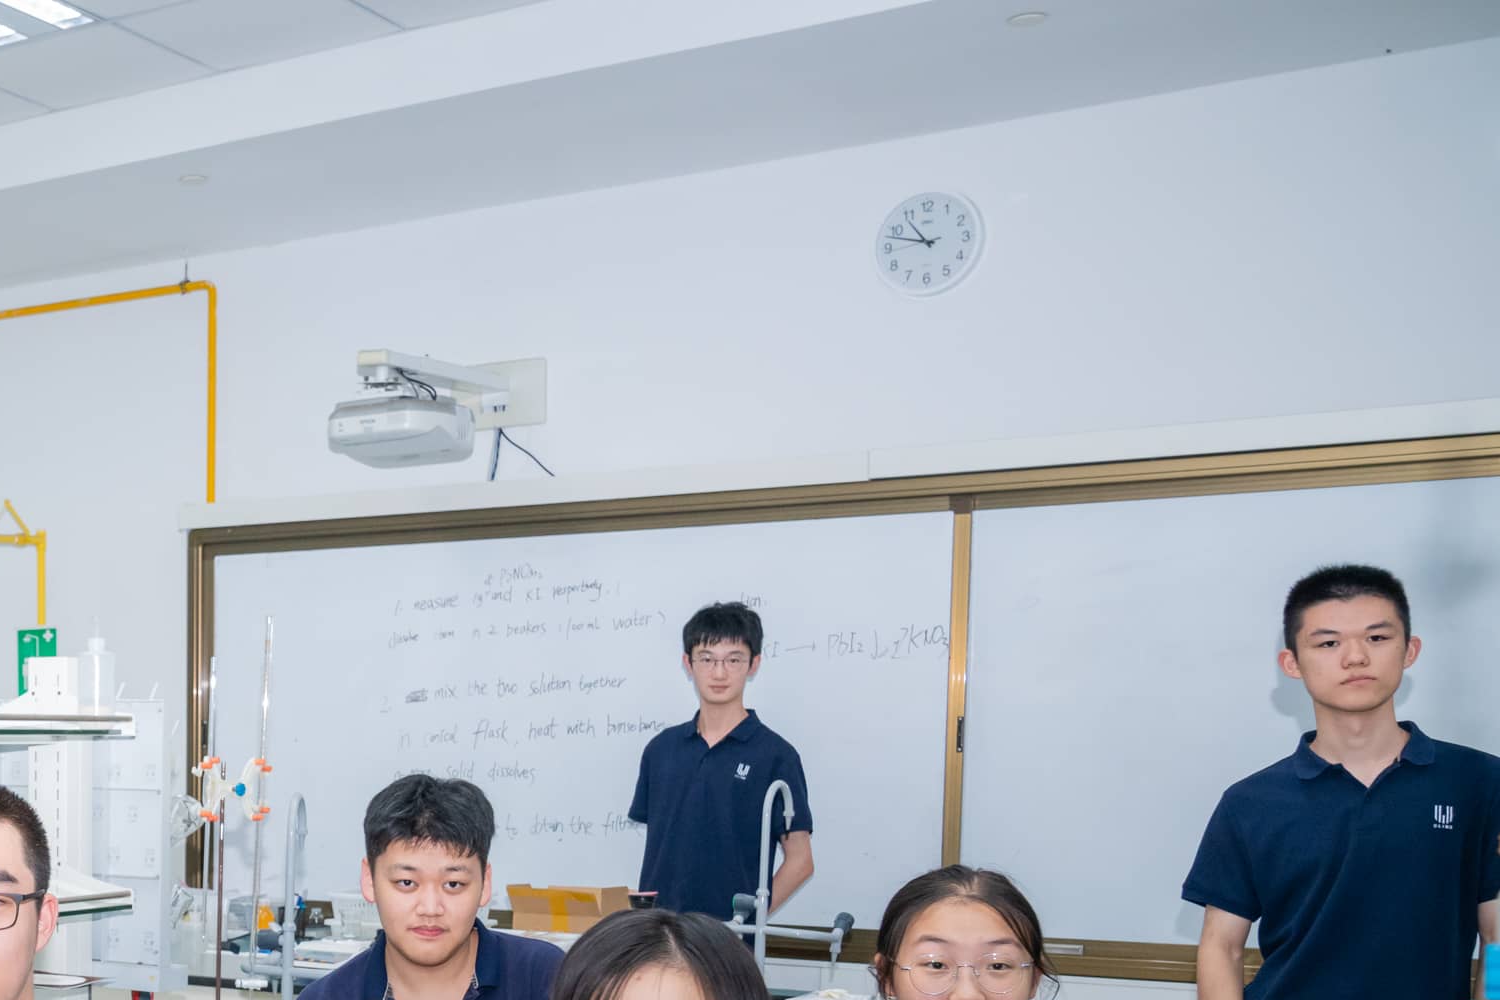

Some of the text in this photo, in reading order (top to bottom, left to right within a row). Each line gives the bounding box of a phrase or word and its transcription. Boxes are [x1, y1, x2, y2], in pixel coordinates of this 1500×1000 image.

[921, 200, 934, 213] 12
[904, 209, 915, 221] 11
[956, 214, 965, 227] 2
[891, 224, 904, 237] 10
[961, 230, 971, 242] 3
[884, 243, 893, 254] 9
[956, 249, 964, 260] 4
[890, 260, 898, 271] 8
[942, 264, 951, 276] 5
[904, 270, 913, 282] 7
[922, 272, 931, 284] 6
[434, 685, 458, 701] mix
[467, 680, 488, 697] the
[528, 716, 559, 741] heat
[567, 718, 596, 738] with
[444, 759, 474, 781] solid
